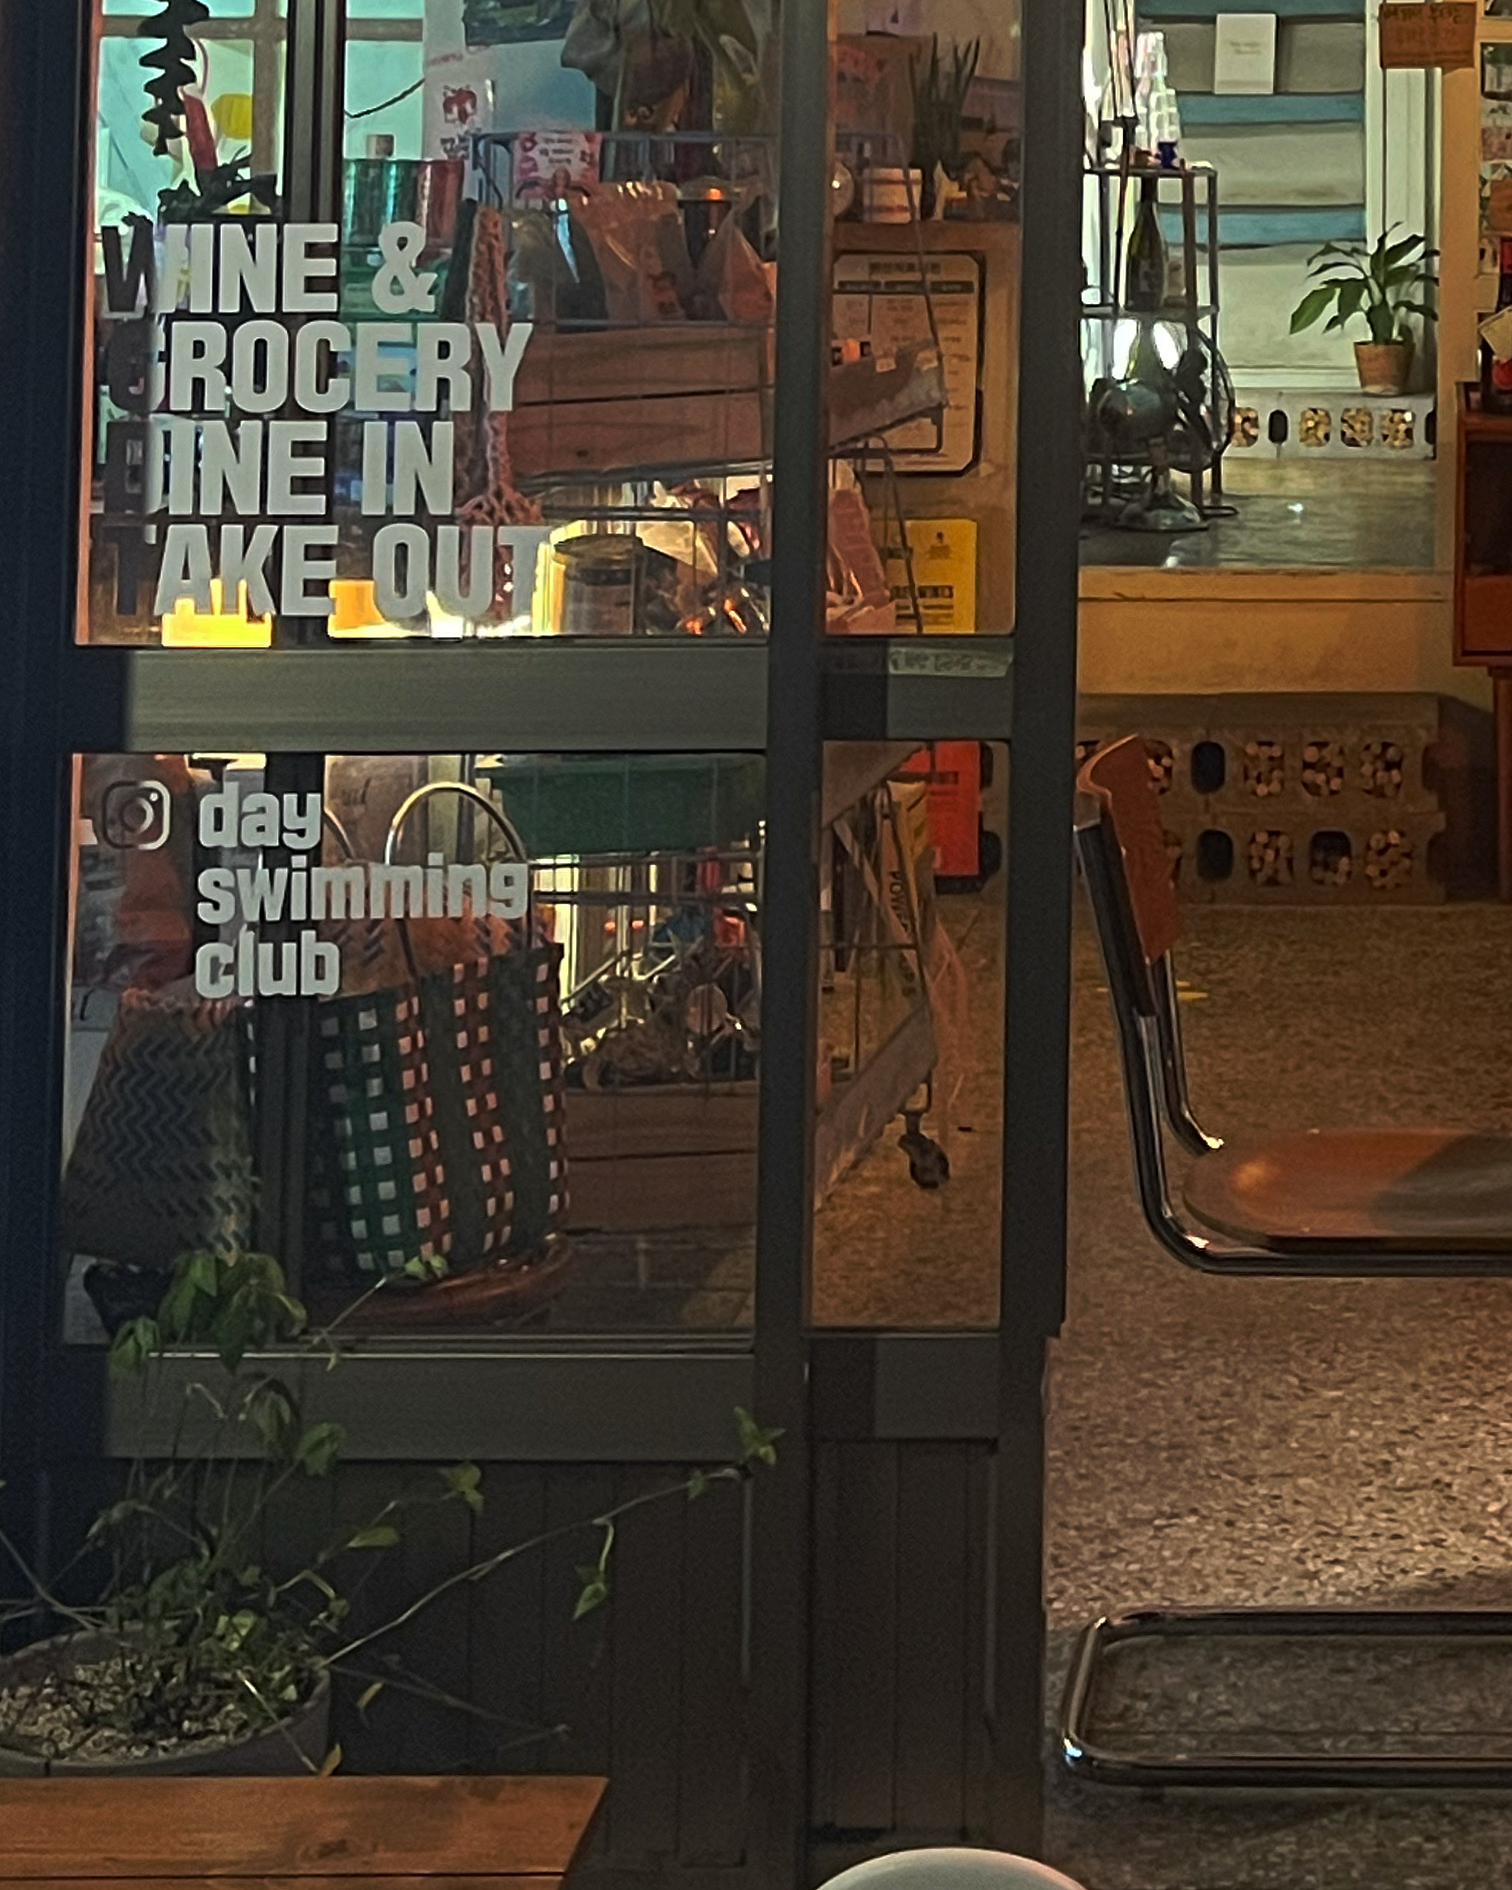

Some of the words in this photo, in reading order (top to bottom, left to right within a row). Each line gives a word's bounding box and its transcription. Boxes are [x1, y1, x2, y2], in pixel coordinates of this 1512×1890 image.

[101, 222, 338, 313] WINE
[371, 221, 439, 314] &
[105, 319, 534, 413] GROCERY
[105, 419, 328, 516] DINE
[361, 421, 454, 516] IN
[103, 523, 339, 616] TAKE
[372, 522, 551, 619] OUT
[199, 781, 322, 849] day
[196, 852, 529, 924] swimming
[194, 929, 342, 999] club
